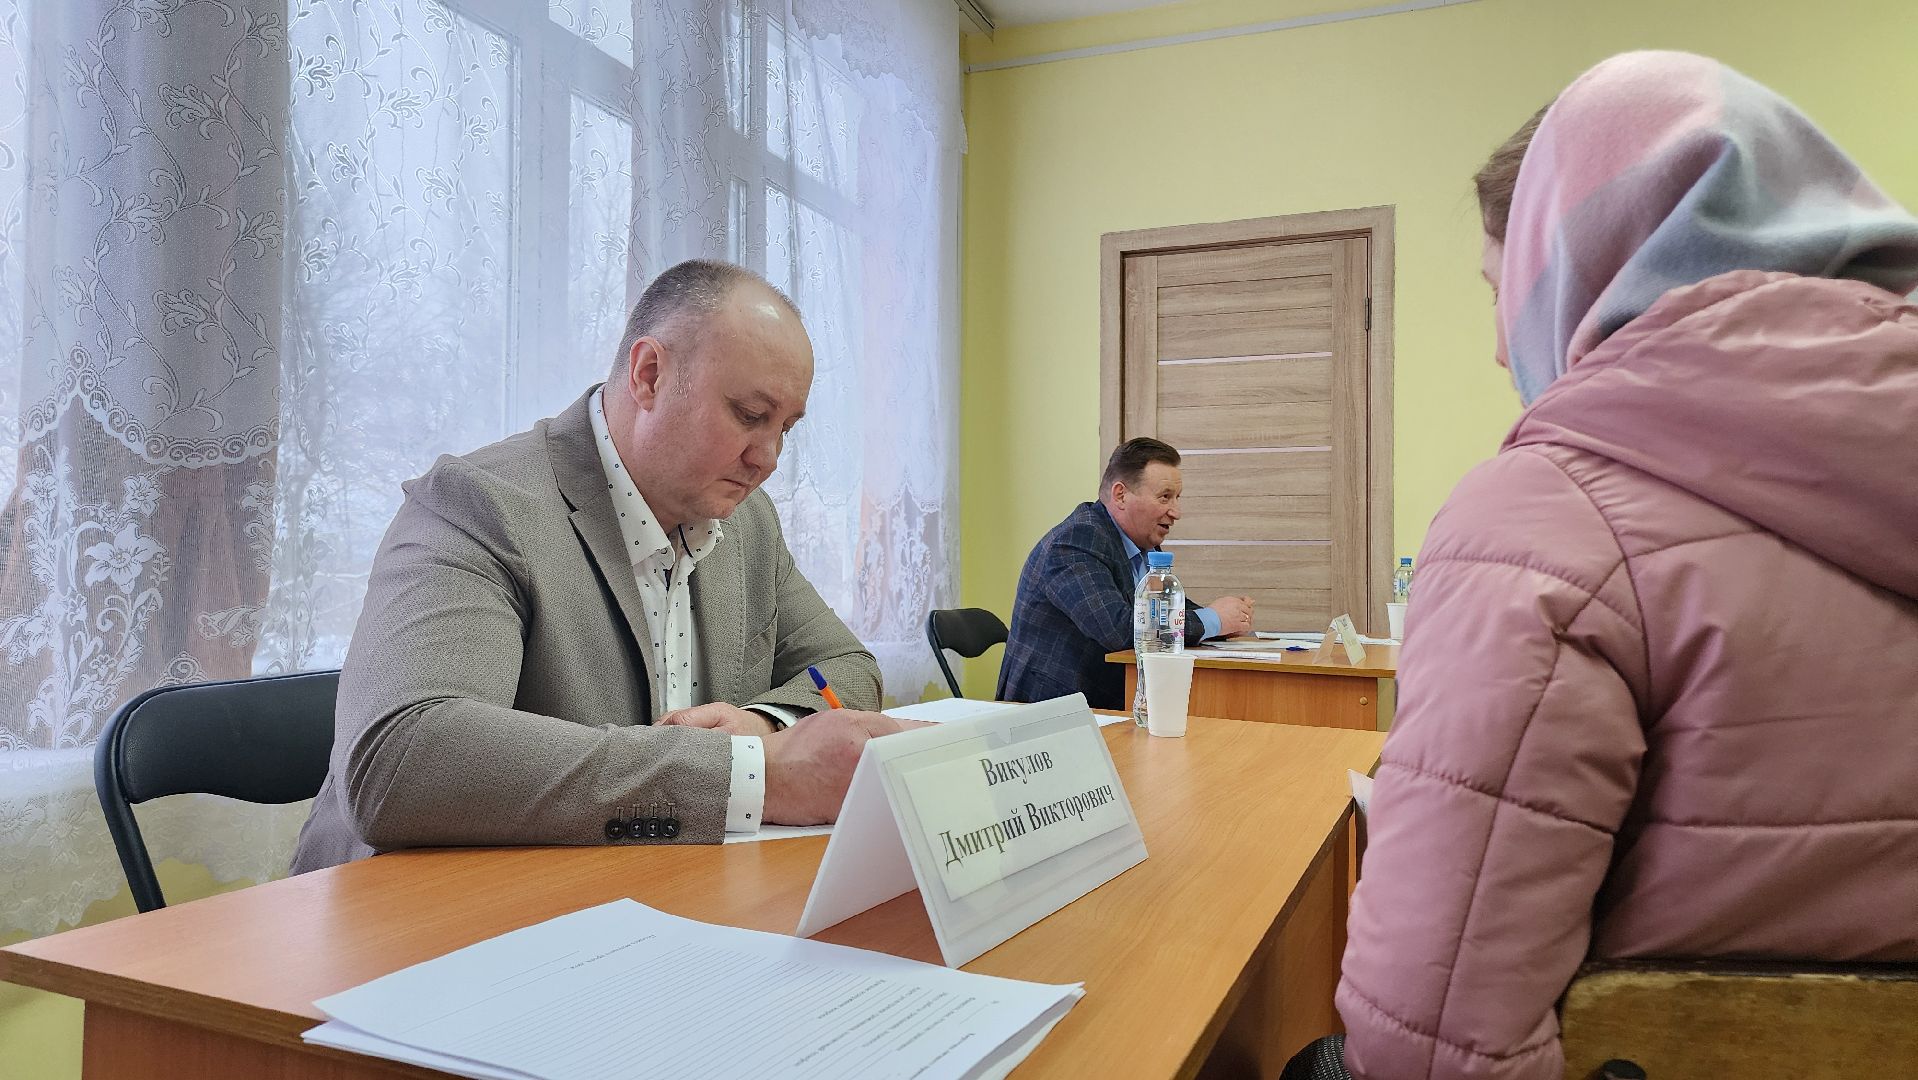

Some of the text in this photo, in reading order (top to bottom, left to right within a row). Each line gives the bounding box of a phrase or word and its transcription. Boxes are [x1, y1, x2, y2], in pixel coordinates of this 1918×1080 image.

[979, 751, 1053, 786] Викулов
[938, 784, 1115, 872] Дмитрий Викторович
